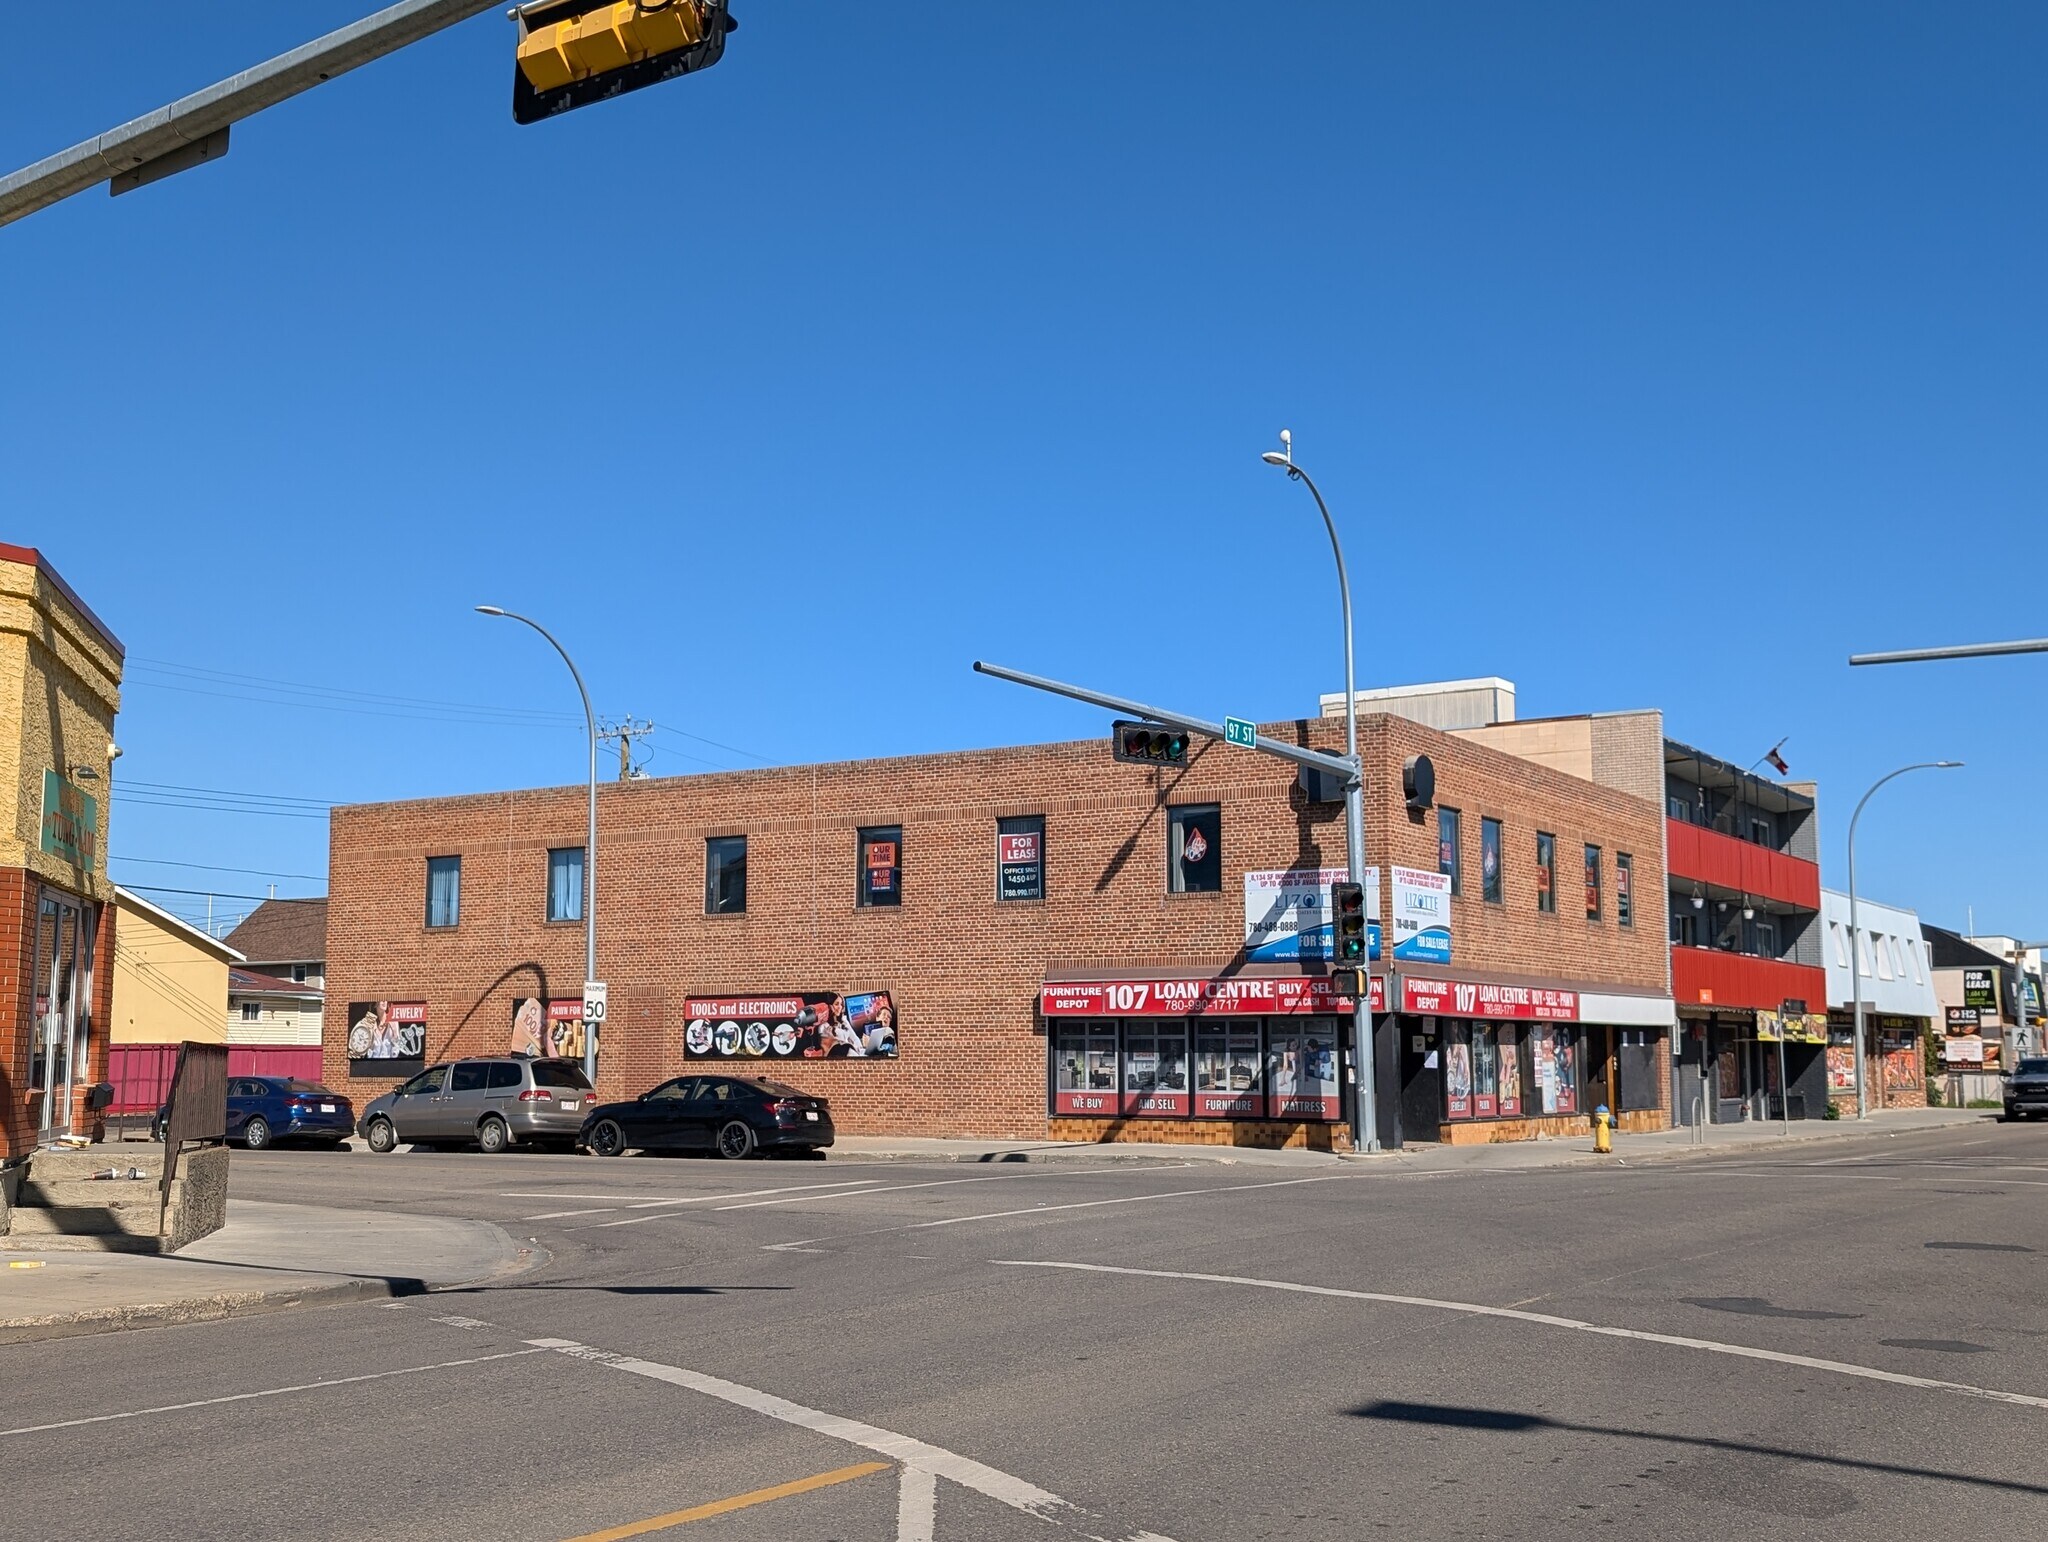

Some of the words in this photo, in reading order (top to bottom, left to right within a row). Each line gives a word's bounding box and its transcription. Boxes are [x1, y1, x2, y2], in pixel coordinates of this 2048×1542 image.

[1229, 722, 1239, 740] 97
[1242, 725, 1253, 742] ST
[1011, 837, 1032, 848] FOR
[872, 845, 890, 854] OUR
[1007, 848, 1036, 860] LEASE
[872, 854, 890, 862] TIME
[1008, 875, 1026, 883] $450
[1275, 872, 1296, 880] INCOME
[1297, 871, 1332, 879] INVESTMENT
[871, 878, 890, 886] TIME
[1405, 892, 1438, 910] LIZOTTE
[1298, 935, 1316, 947] FOR
[1966, 972, 1983, 980] FOR
[1154, 982, 1199, 999] LOAN
[1205, 980, 1275, 999] CENTRE
[1278, 983, 1303, 995] BUY
[1311, 982, 1332, 994] SEL
[1408, 979, 1448, 995] FURNITURE
[1966, 980, 1991, 988] LEASE
[1043, 987, 1101, 996] FURNITURE
[1105, 984, 1149, 1010] 107
[1479, 985, 1499, 1003] LOAN
[1500, 986, 1529, 1005] CENTRE
[1531, 989, 1543, 1005] BUY
[1056, 999, 1090, 1009] DEPOT
[1416, 996, 1439, 1010] DEPOT
[1454, 983, 1476, 1013] 107
[551, 1006, 568, 1015] PAWN
[569, 1006, 581, 1015] FOR
[585, 1000, 605, 1018] 50
[690, 1003, 718, 1016] TOOLS
[719, 1003, 737, 1015] and
[739, 1001, 798, 1015] ELECTRONICS
[1164, 999, 1239, 1011] 780-990-1717
[391, 1006, 424, 1020] JEWELRY
[1961, 1009, 1977, 1018] H2
[1072, 1097, 1085, 1109] WE
[1087, 1097, 1103, 1109] BUY
[1138, 1099, 1156, 1110] AND
[1158, 1098, 1176, 1110] SELL
[1205, 1099, 1252, 1112] FURNITURE
[1281, 1100, 1326, 1113] MATTRESS
